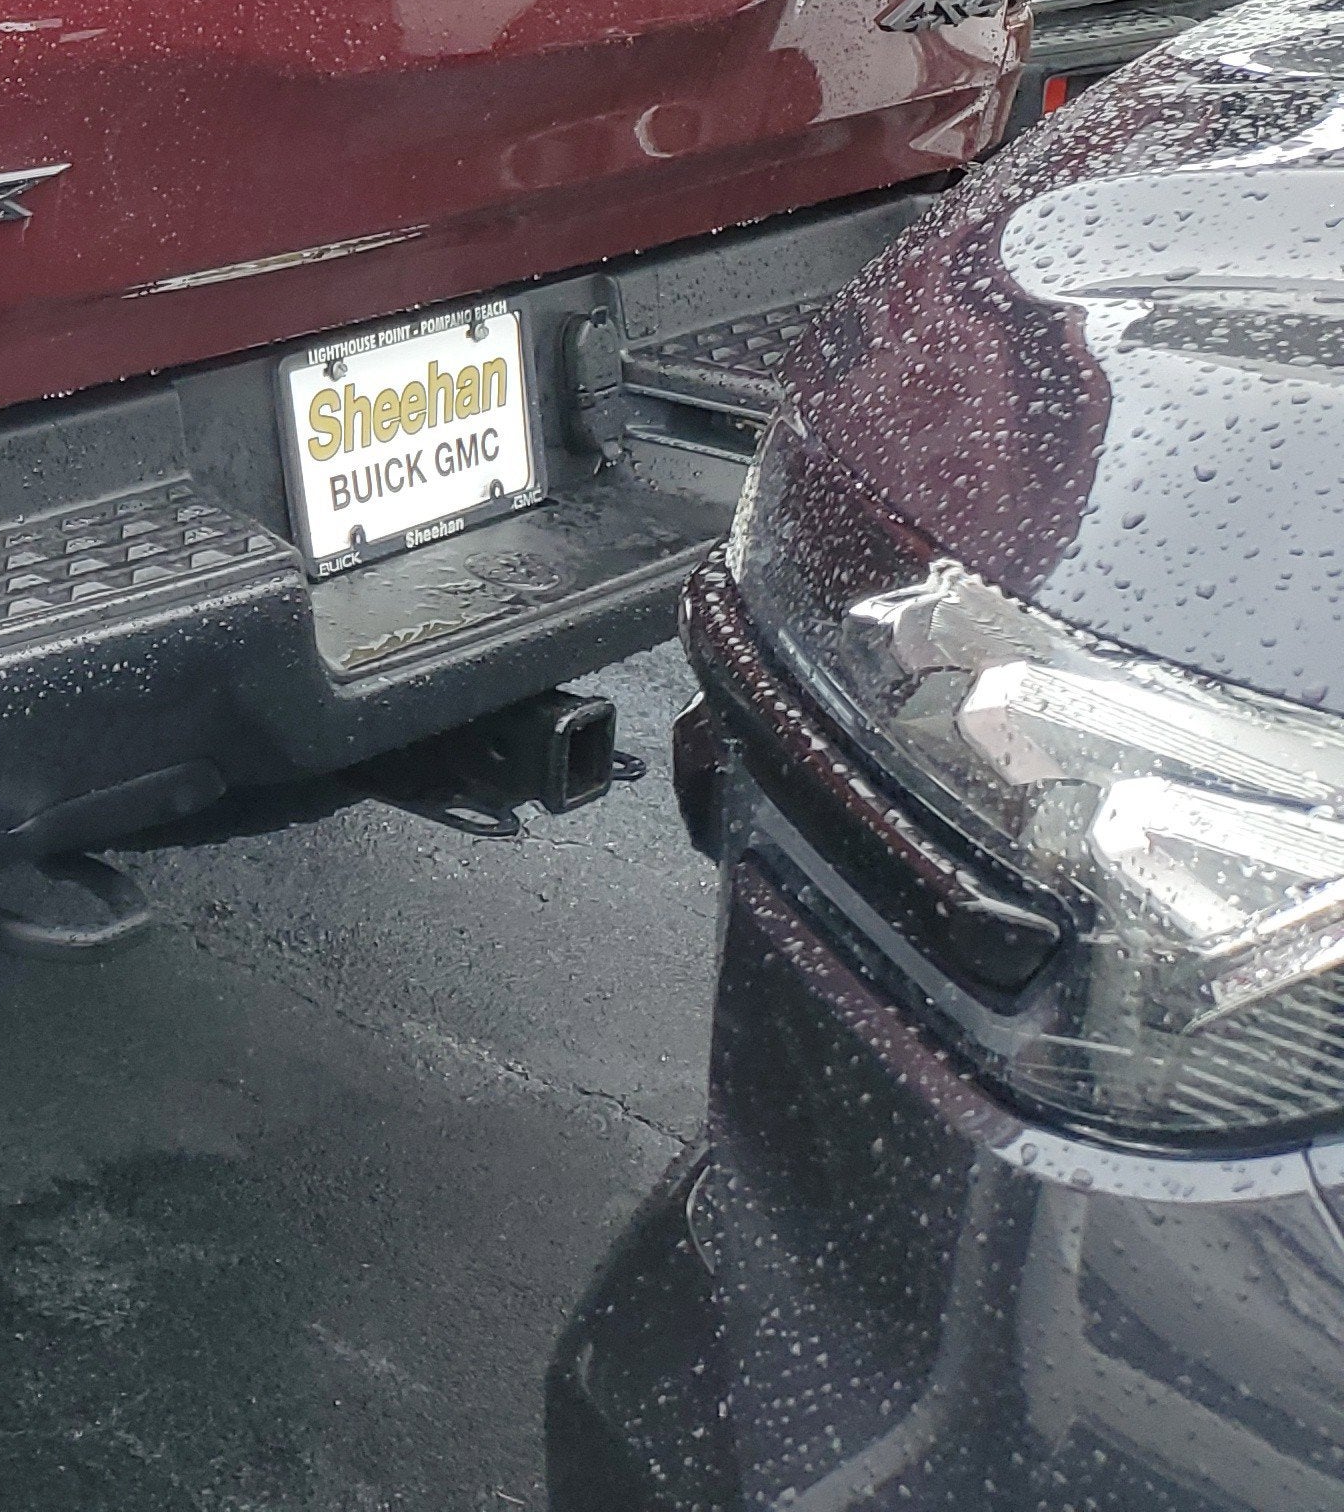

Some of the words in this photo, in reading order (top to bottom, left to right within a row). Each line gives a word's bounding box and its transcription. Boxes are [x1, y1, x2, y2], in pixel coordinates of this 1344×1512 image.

[307, 336, 376, 365] LIGHTHOUSE
[378, 326, 411, 347] POINT
[420, 309, 473, 336] POMPANO
[475, 300, 508, 322] BEACH
[307, 356, 508, 462] Sheehan
[329, 449, 428, 511] BUICK
[434, 427, 500, 478] GMC
[318, 551, 363, 577] BUICK
[404, 517, 465, 549] Sheehan
[513, 489, 543, 511] GMC
